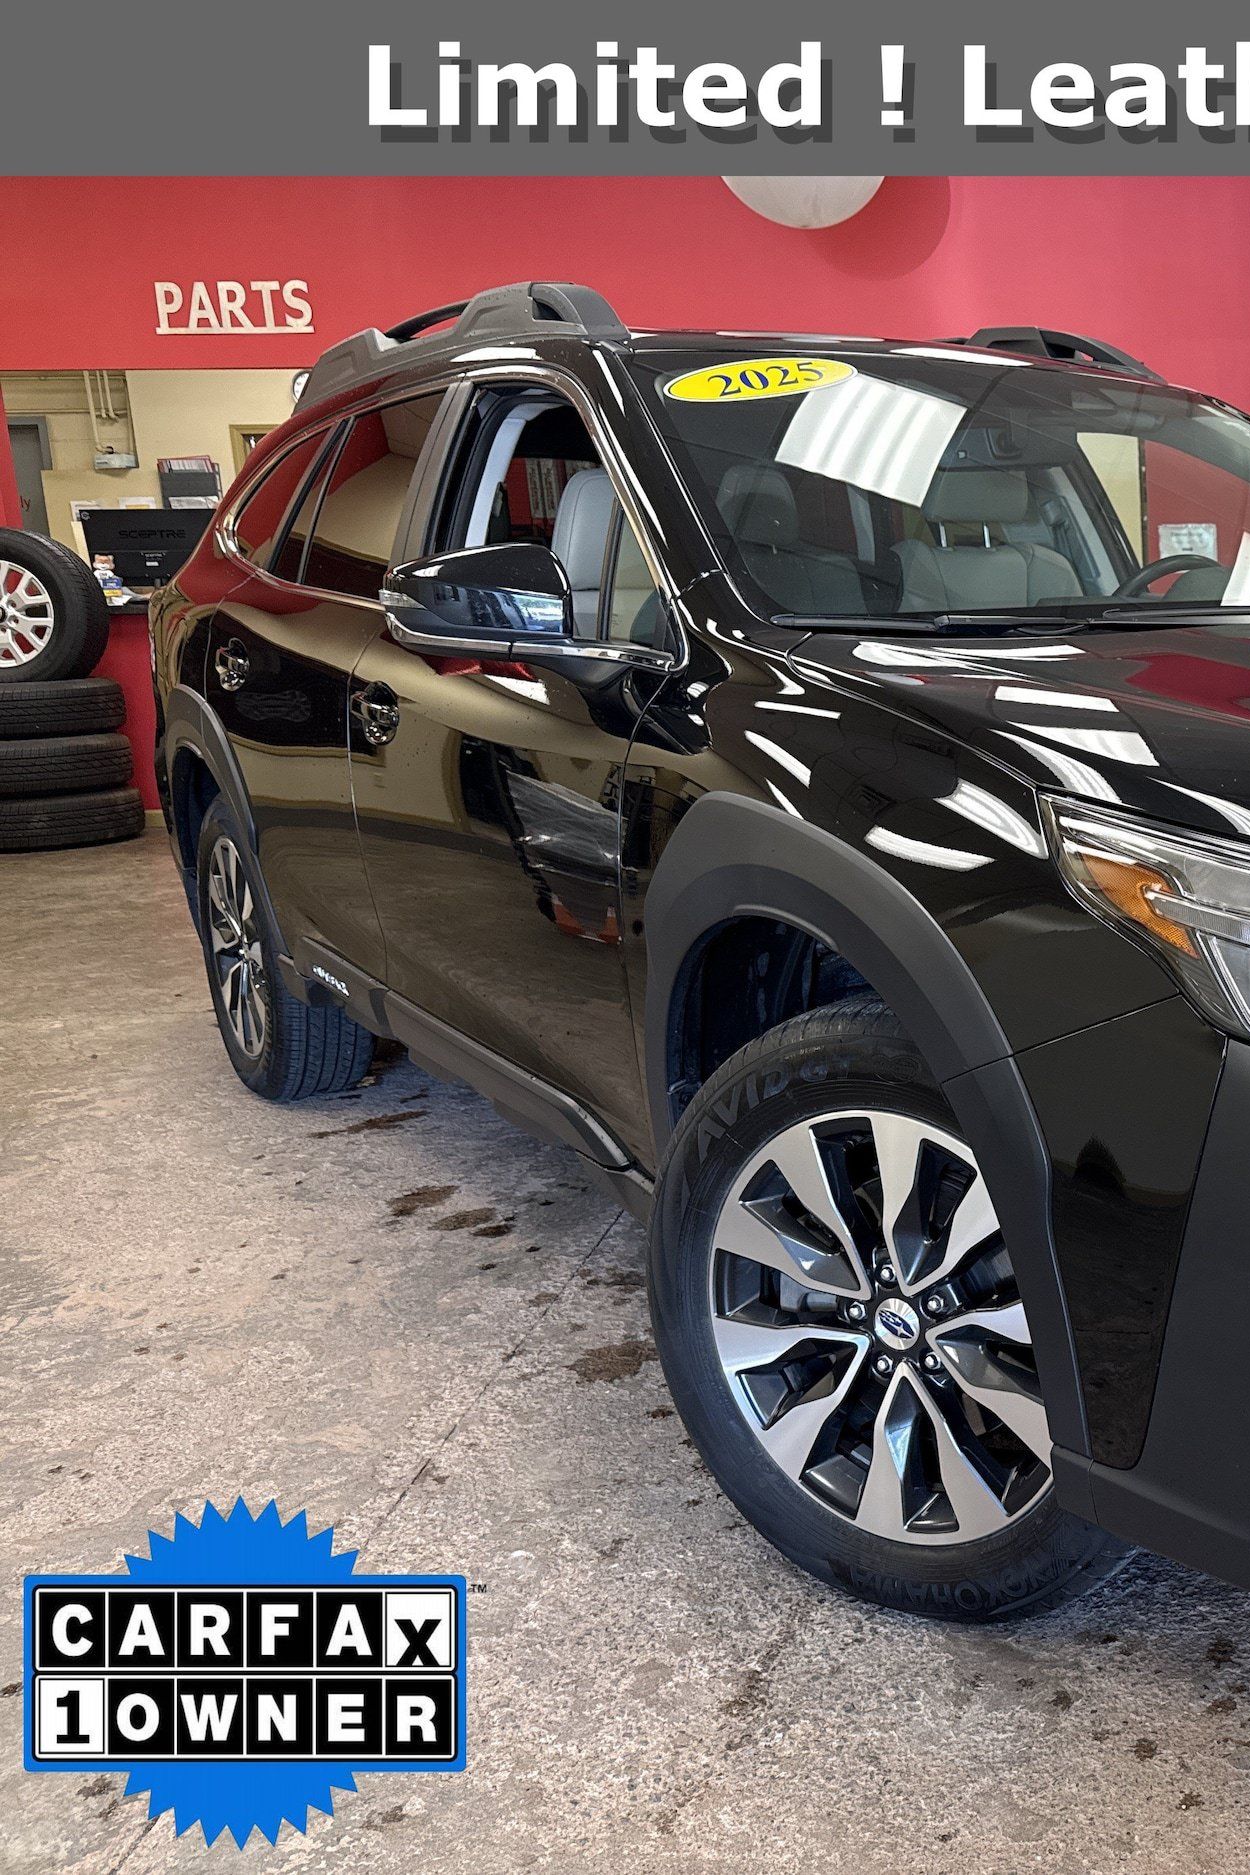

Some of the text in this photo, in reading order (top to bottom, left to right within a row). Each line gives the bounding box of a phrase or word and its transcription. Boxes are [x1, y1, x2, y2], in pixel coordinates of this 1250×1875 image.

[154, 279, 314, 330] PARTS
[707, 362, 824, 397] 2025
[118, 529, 187, 539] SCEPTRE
